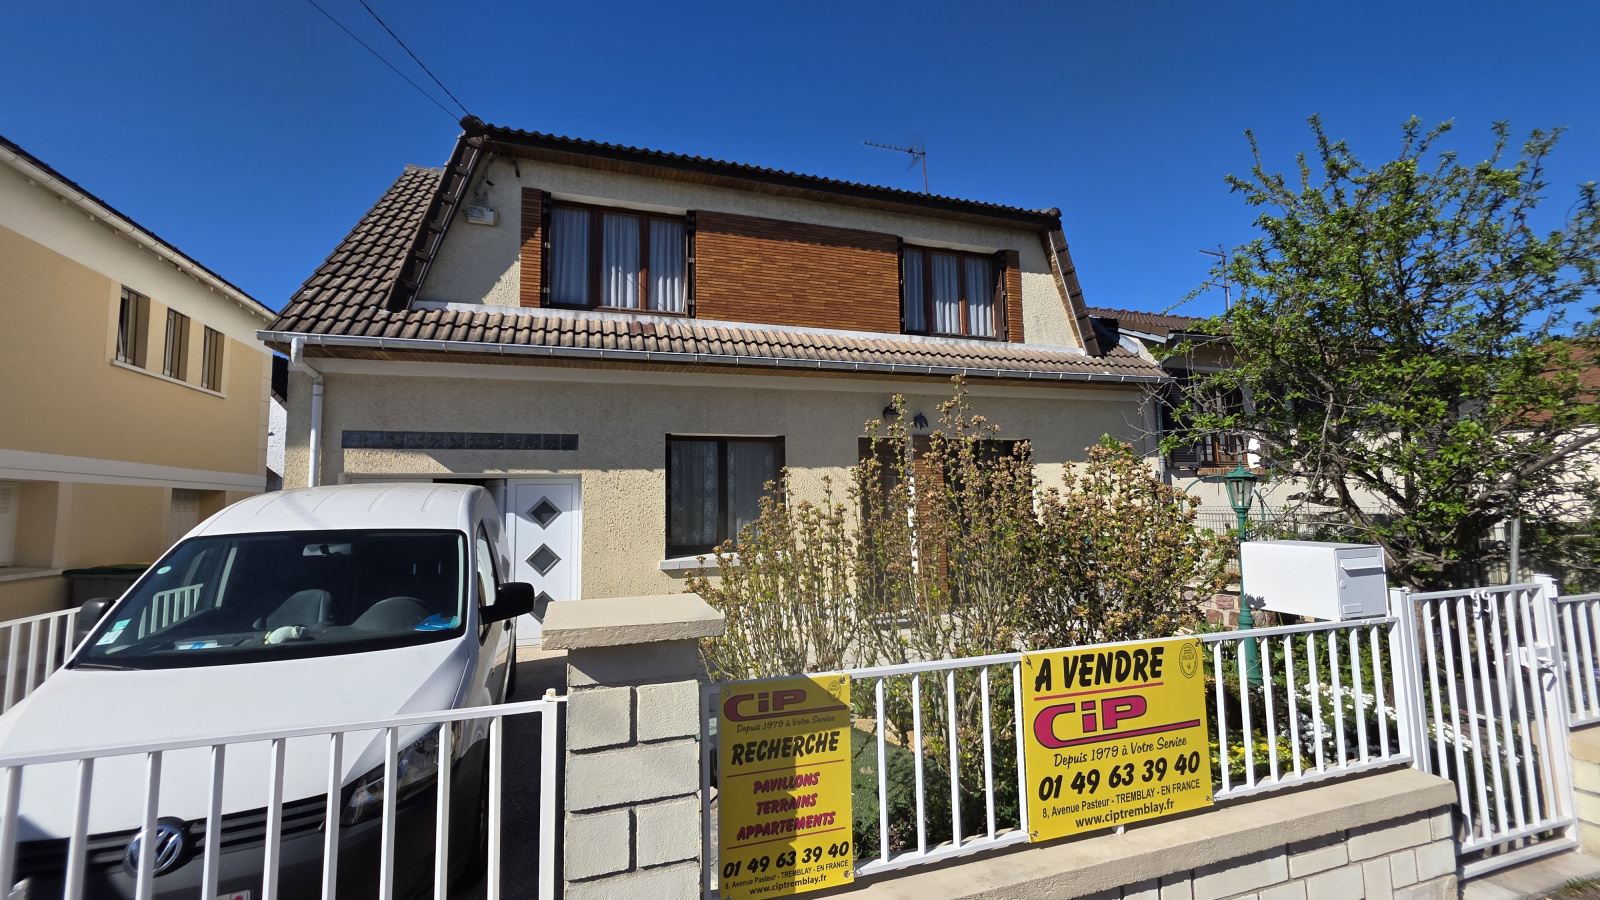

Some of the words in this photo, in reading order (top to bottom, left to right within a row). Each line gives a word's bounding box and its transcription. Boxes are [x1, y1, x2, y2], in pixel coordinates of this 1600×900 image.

[1034, 658, 1052, 692] A
[1063, 646, 1165, 689] VENDRE
[736, 724, 760, 736] Depuis
[763, 720, 784, 730] 1979
[786, 718, 790, 727] à
[792, 717, 810, 726] Votre
[812, 715, 836, 724] Service
[731, 731, 840, 766] RECHERCHE
[1053, 753, 1088, 769] Depuis
[1090, 746, 1119, 762] 1979
[1121, 745, 1128, 756] à
[1130, 742, 1154, 755] Votre
[1157, 736, 1187, 750] Service
[753, 772, 820, 794] PAVILLONS
[1038, 774, 1063, 801] 01
[1070, 769, 1100, 795] 49
[1108, 762, 1135, 789] 63
[1141, 757, 1168, 782] 39
[1174, 751, 1200, 776] 40
[756, 793, 818, 815] TERRAINS
[1042, 807, 1050, 819] 8,
[1051, 803, 1080, 817] Avenue
[1081, 797, 1109, 811] Pasteur
[1116, 787, 1155, 804] TREMBLAY
[1161, 785, 1171, 796] EN
[1172, 778, 1201, 793] FRANCE
[1075, 798, 1175, 828] www.ciptremblay.fr
[736, 811, 836, 840] APPARTEMENTS
[723, 861, 742, 878] 01
[747, 856, 770, 874] 49
[776, 851, 796, 868] 63
[802, 846, 822, 863] 39
[828, 841, 850, 858] 40
[732, 879, 754, 889] Avenue
[755, 874, 776, 884] Pasteur
[781, 867, 812, 878] TREMBLAY
[816, 864, 824, 872] EN
[826, 860, 848, 870] FRANCE
[749, 874, 826, 895] www.ciptremblay.fr
